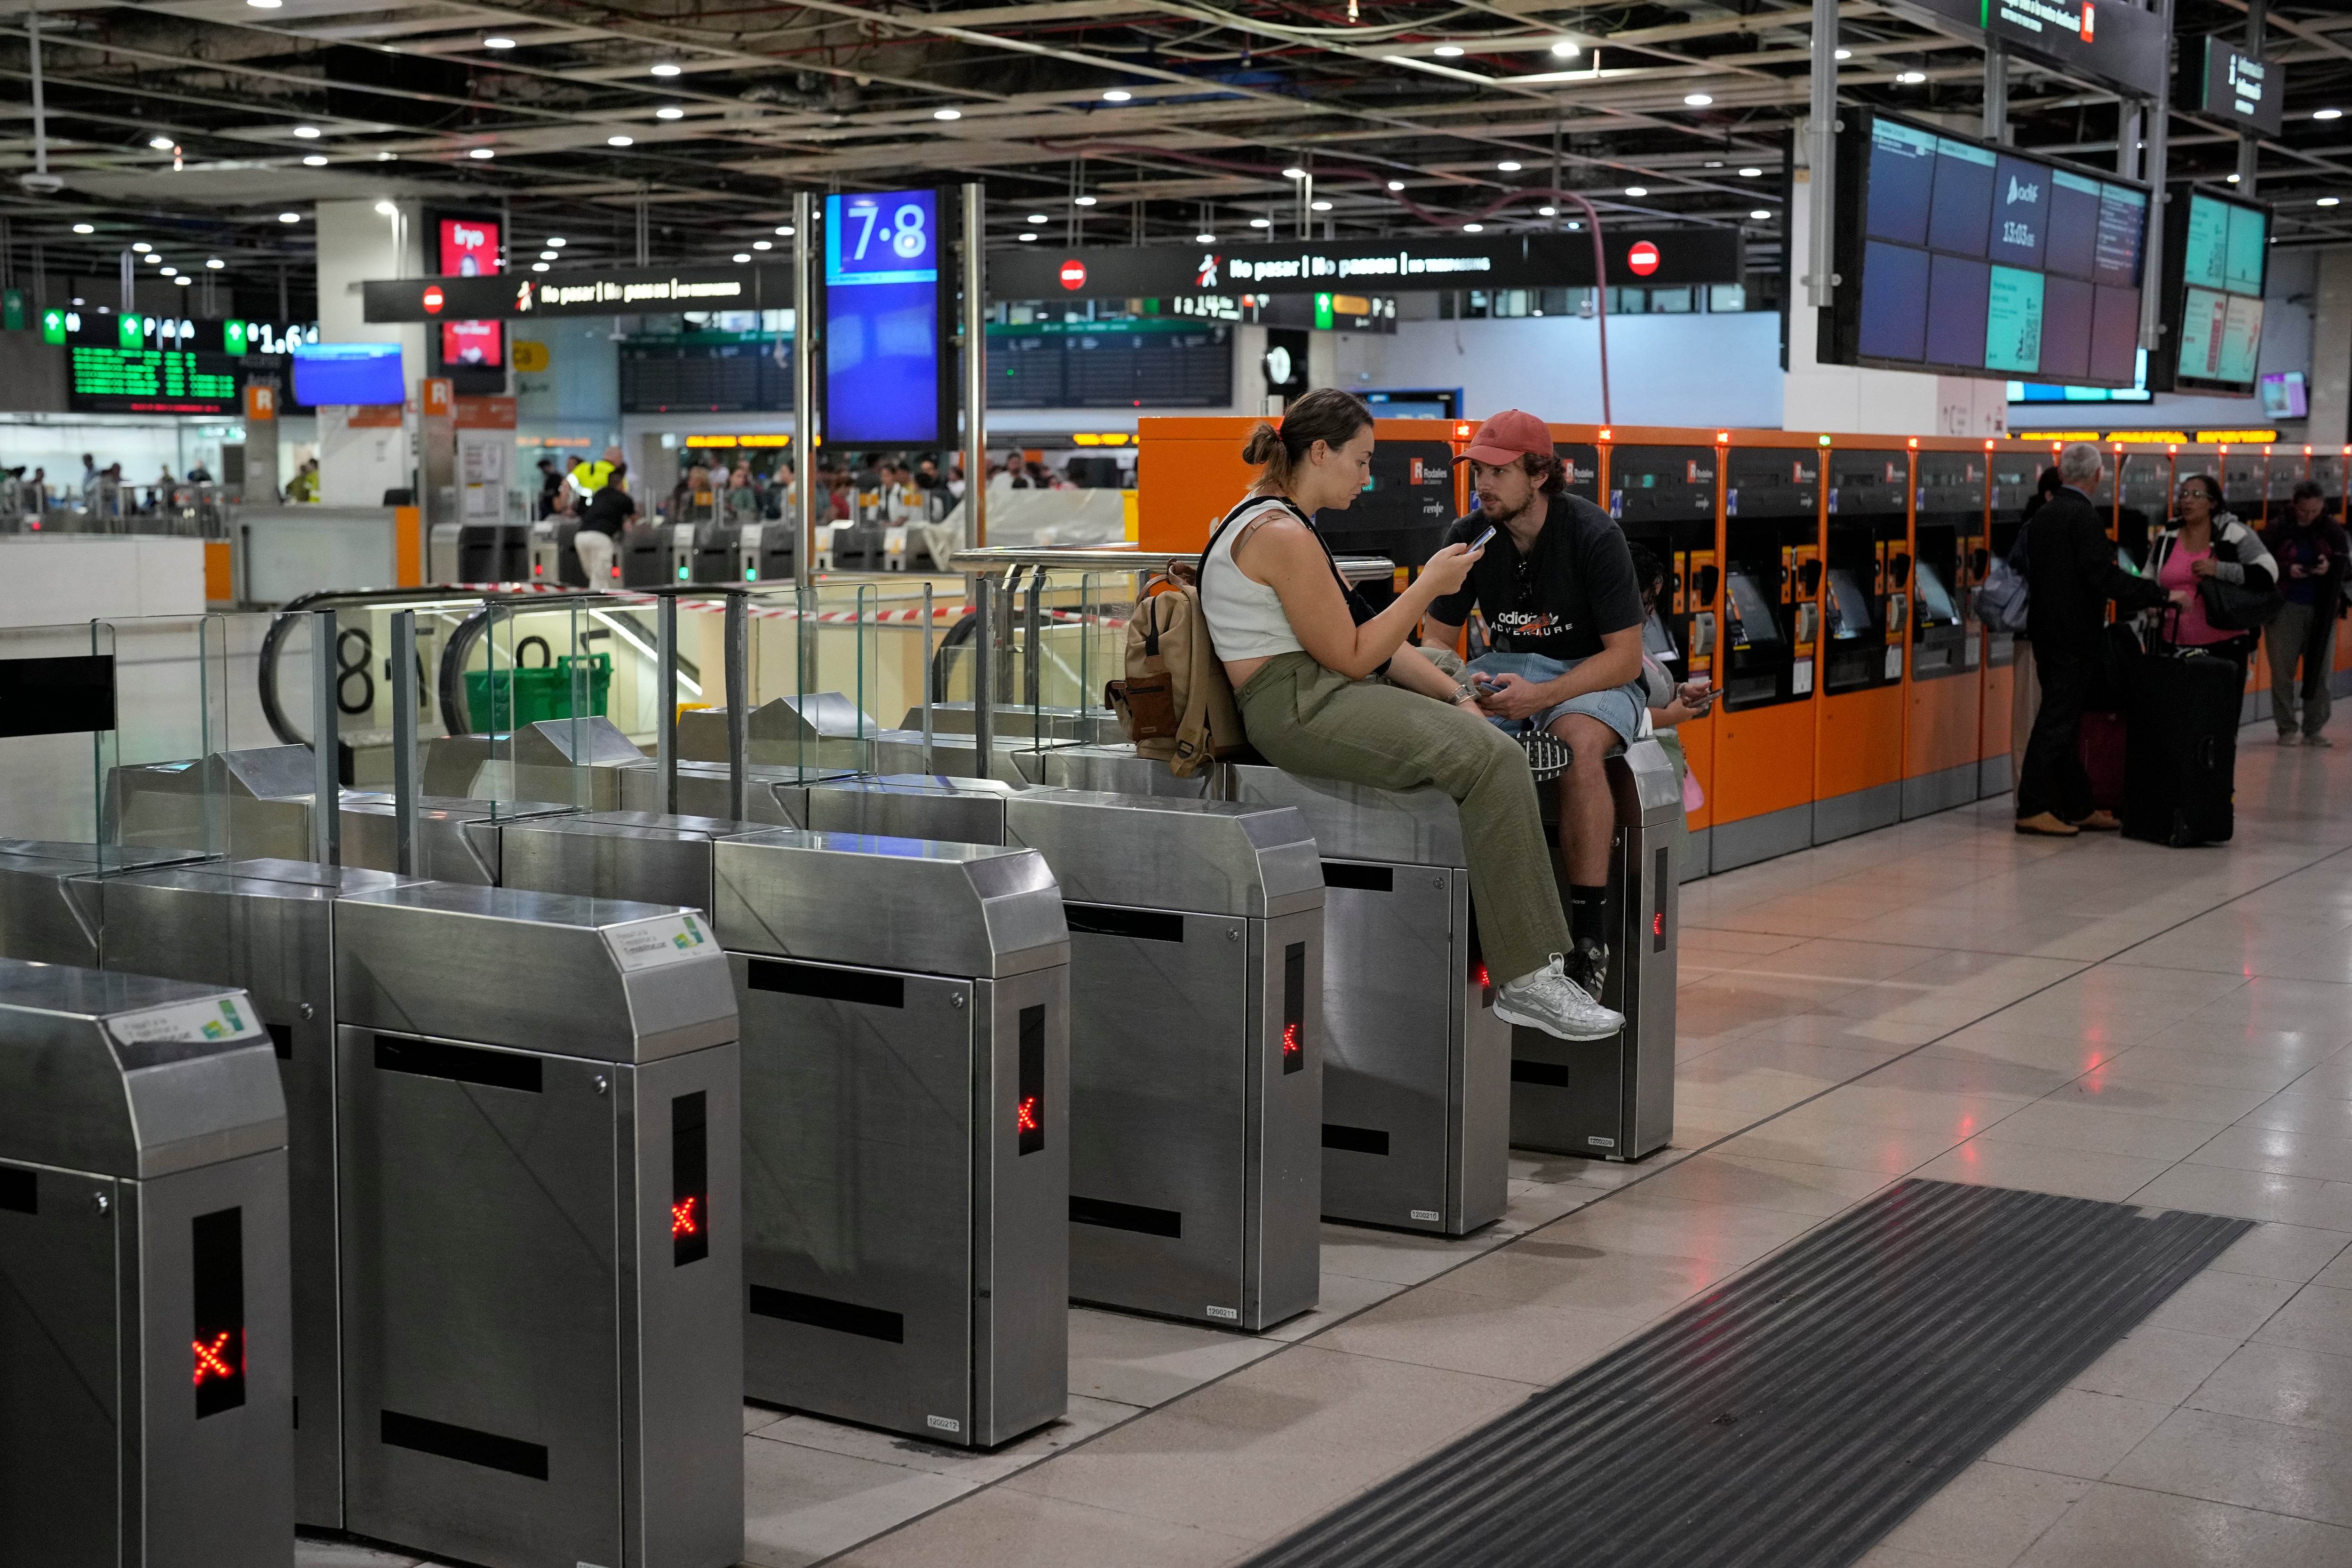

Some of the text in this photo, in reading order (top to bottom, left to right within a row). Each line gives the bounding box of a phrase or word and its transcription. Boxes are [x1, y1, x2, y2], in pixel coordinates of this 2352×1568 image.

[1230, 259, 1253, 278] No
[1254, 260, 1300, 281] pasar
[257, 389, 273, 411] R
[432, 383, 446, 404] R
[1415, 462, 1423, 478] R
[1412, 1210, 1437, 1219] 1200210
[1208, 1307, 1234, 1317] 1200211
[929, 1417, 957, 1429] 1200212
